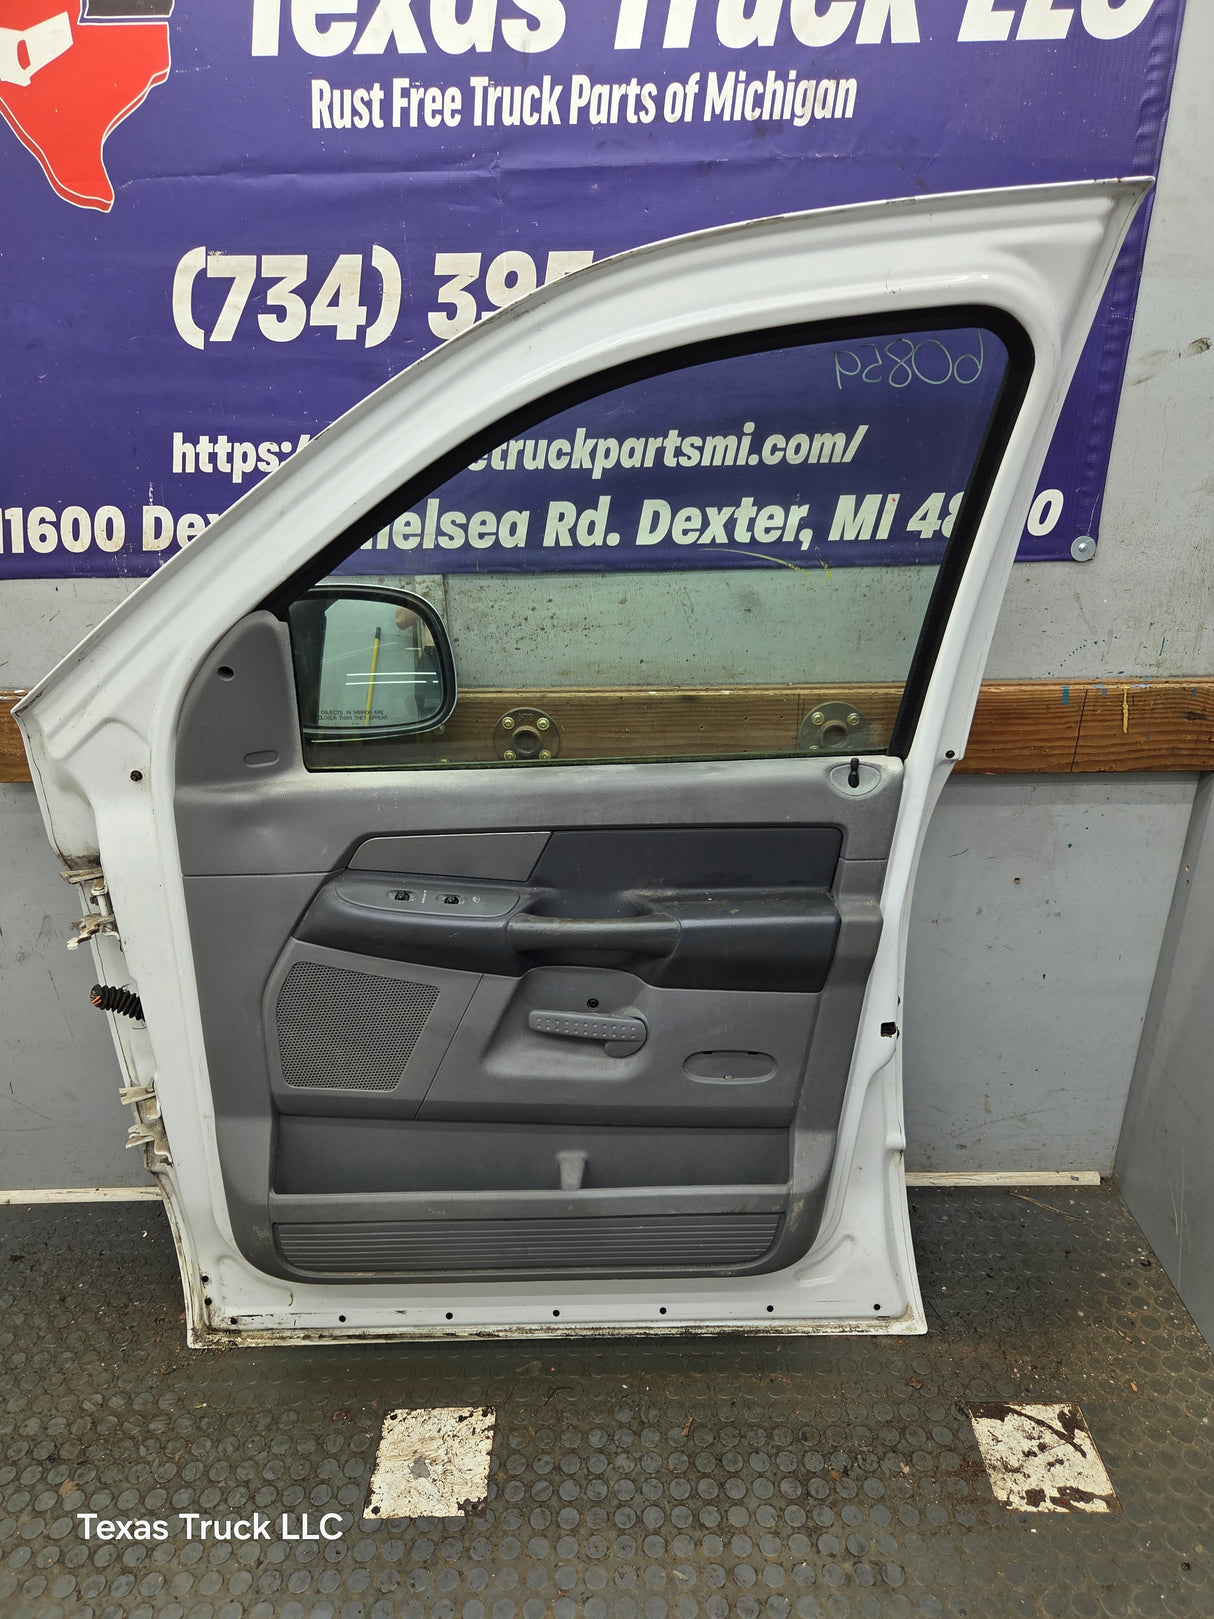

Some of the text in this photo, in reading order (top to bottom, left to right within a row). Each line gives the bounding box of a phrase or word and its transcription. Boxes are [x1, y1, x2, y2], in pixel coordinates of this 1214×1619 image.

[311, 69, 858, 129] Rust Free Truck Parts of Michigan
[172, 245, 401, 350] (734)
[543, 496, 620, 547] Rd.
[635, 496, 812, 551] Dexter,
[827, 493, 900, 541] MI
